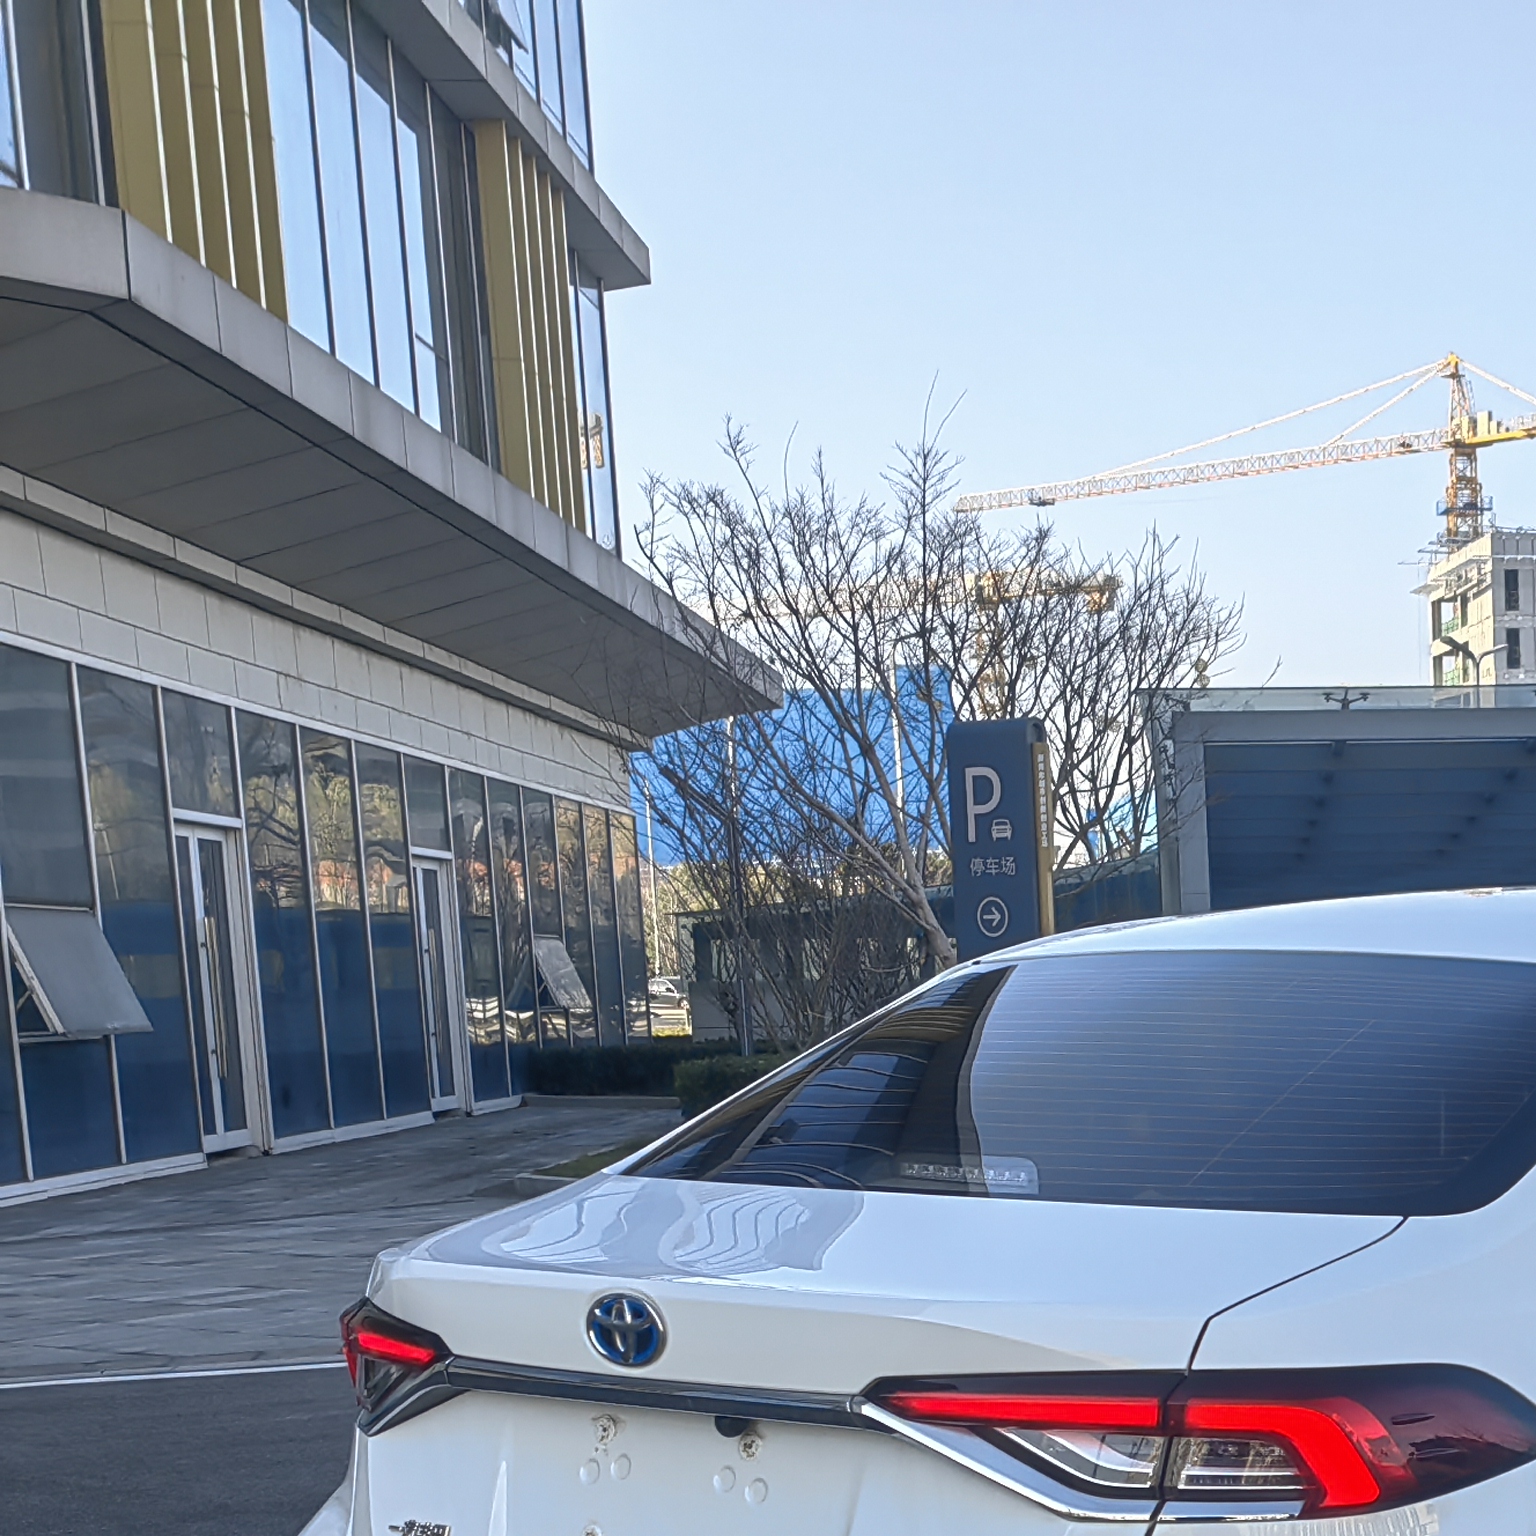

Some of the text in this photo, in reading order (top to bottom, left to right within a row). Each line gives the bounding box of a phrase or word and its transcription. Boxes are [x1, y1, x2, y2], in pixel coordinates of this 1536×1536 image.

[964, 766, 1002, 843] P
[970, 856, 1016, 877] 停车场
